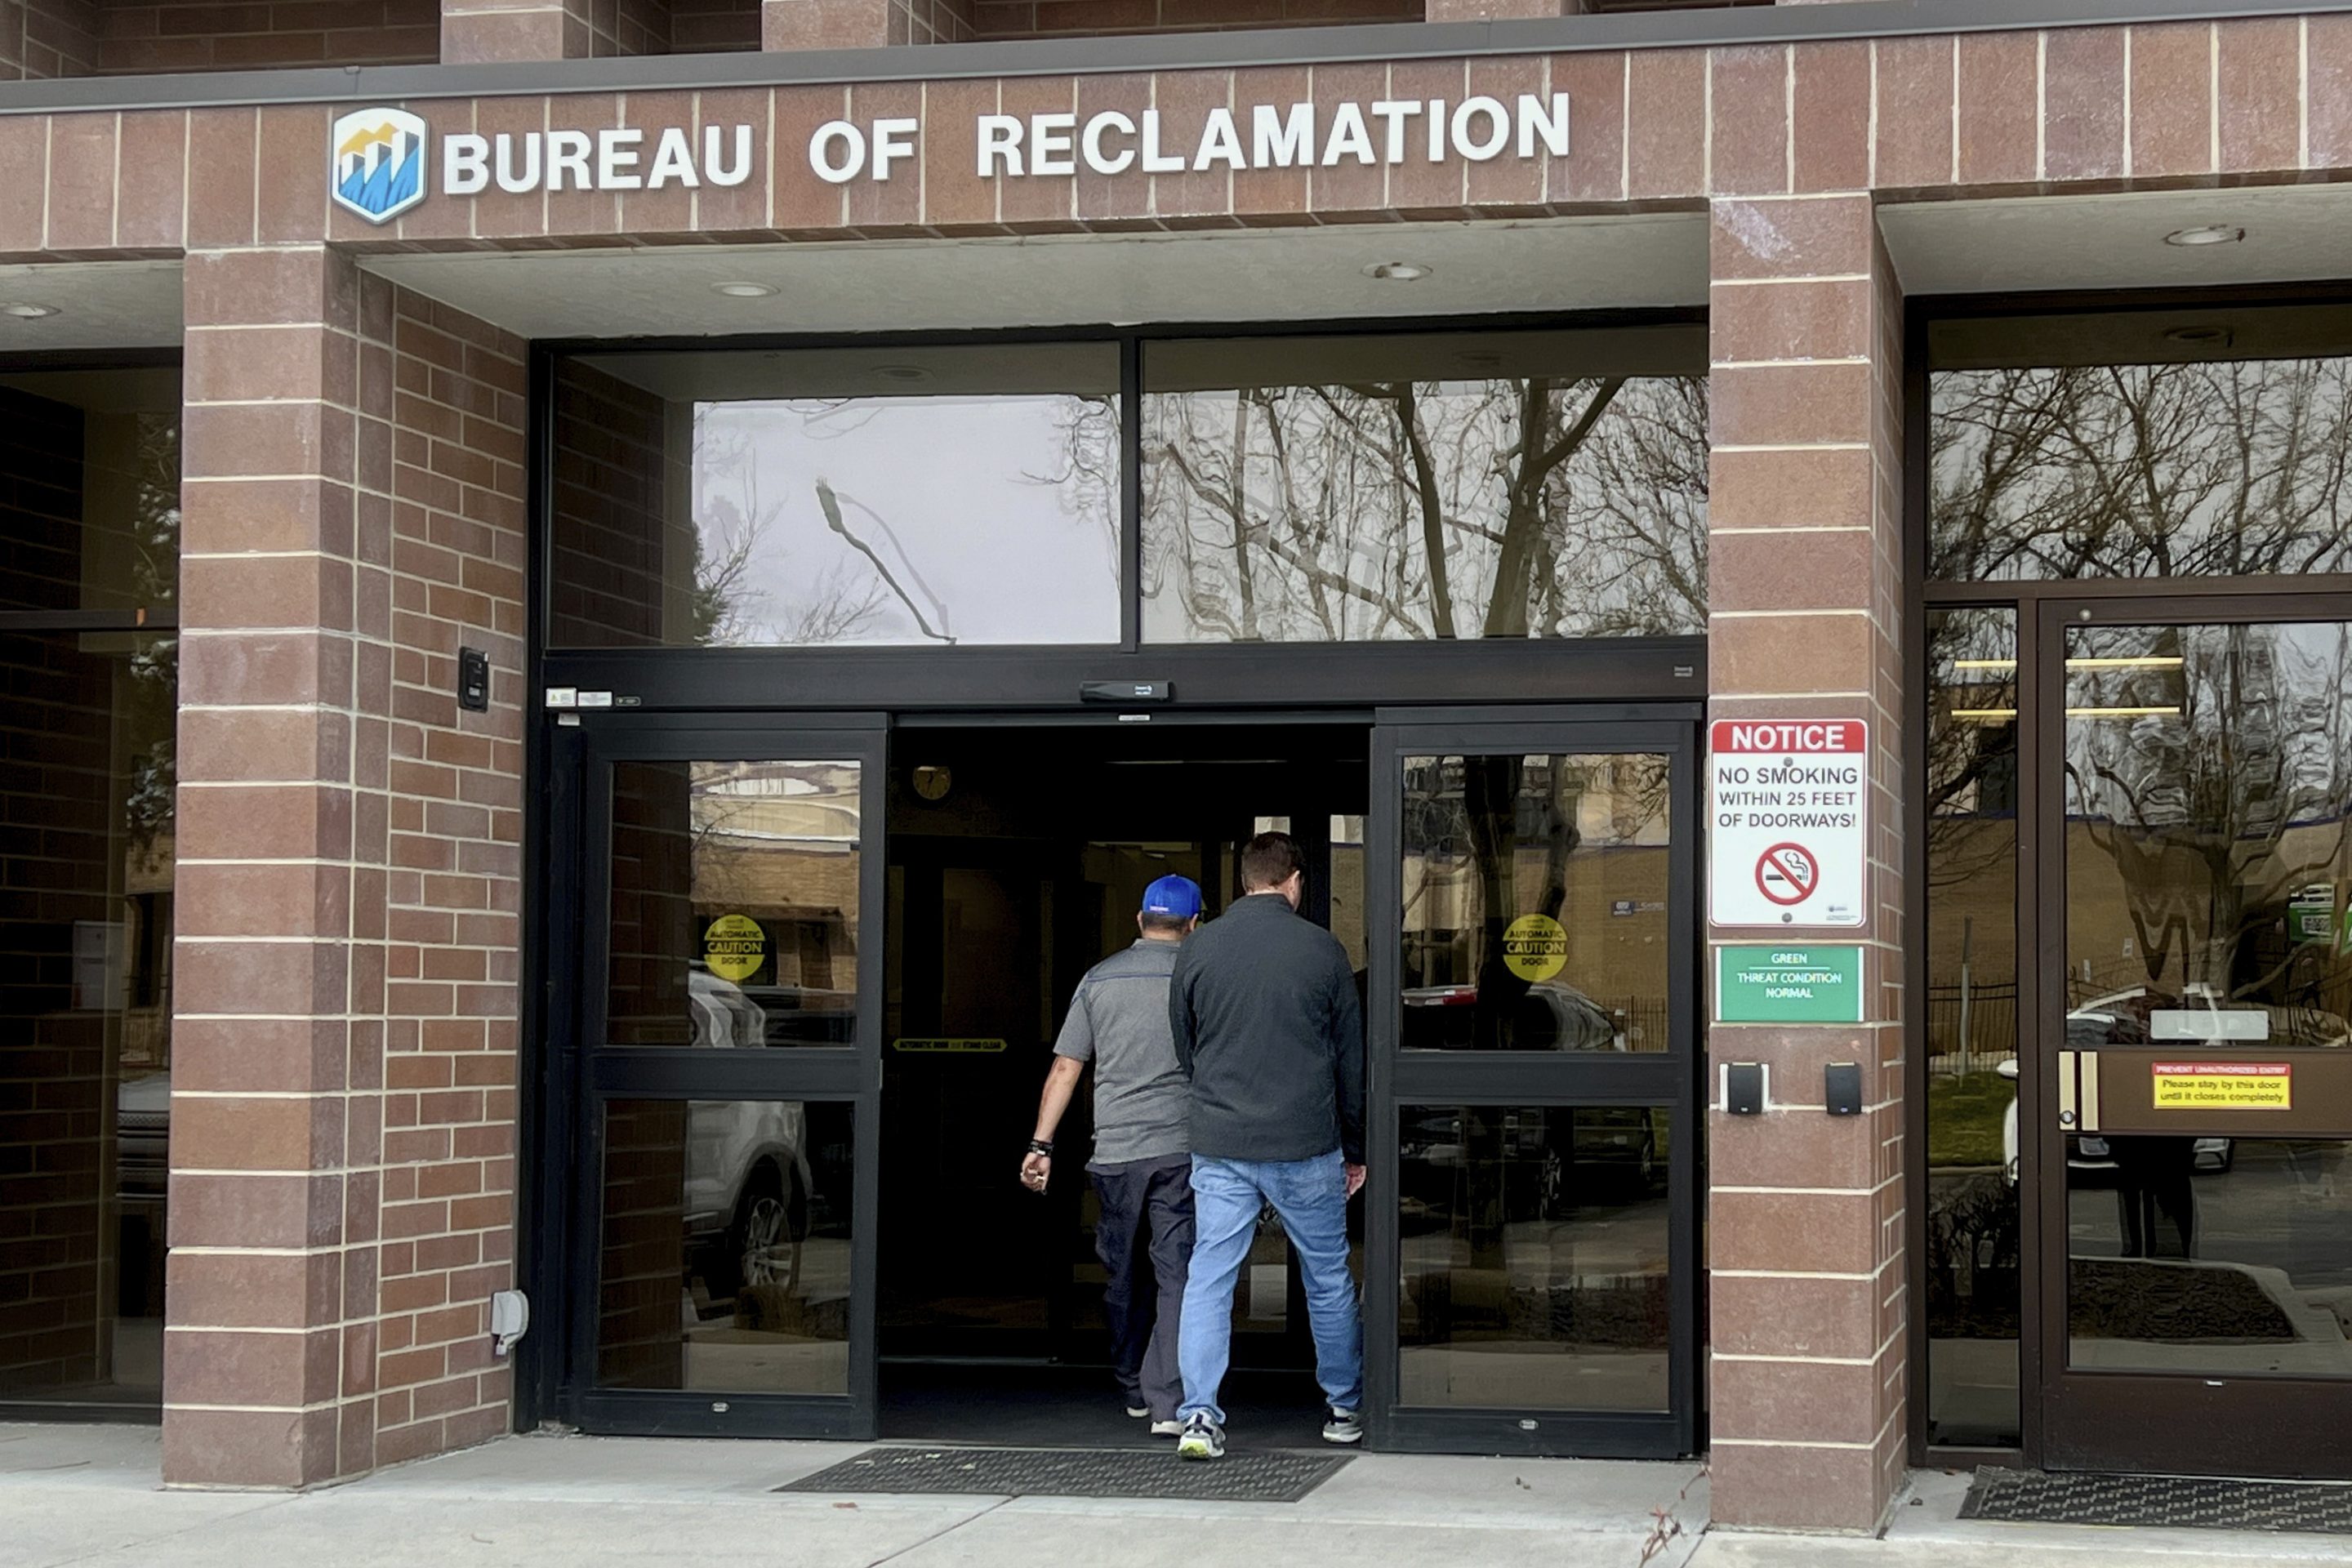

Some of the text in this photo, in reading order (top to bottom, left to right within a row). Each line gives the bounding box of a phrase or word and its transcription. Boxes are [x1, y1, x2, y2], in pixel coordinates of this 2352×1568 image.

[443, 92, 1570, 194] BUREAU OF RECLAMATION
[1731, 725, 1846, 751] NOTICE
[1718, 767, 1858, 784] NO SMOKING
[1719, 791, 1856, 806] WITHIN 25 FEET
[1718, 813, 1856, 828] OF DOORWAYS!
[710, 930, 760, 938] AUTOMATIC
[1508, 929, 1563, 938] AUTOMATIC
[707, 942, 762, 953] CAUTION
[1506, 942, 1566, 953] CAUTION
[721, 956, 748, 965] DOOR
[1521, 957, 1549, 965] DOOR
[1771, 953, 1807, 964] GREEN
[1737, 972, 1842, 984] THREAT CONDITION
[1766, 987, 1814, 999] NORMAL
[2155, 1065, 2287, 1074] PREVENT UNAUTHORIZED ENTRY
[2163, 1079, 2282, 1090] Please stay by this door
[2160, 1091, 2283, 1103] until it closes completely
